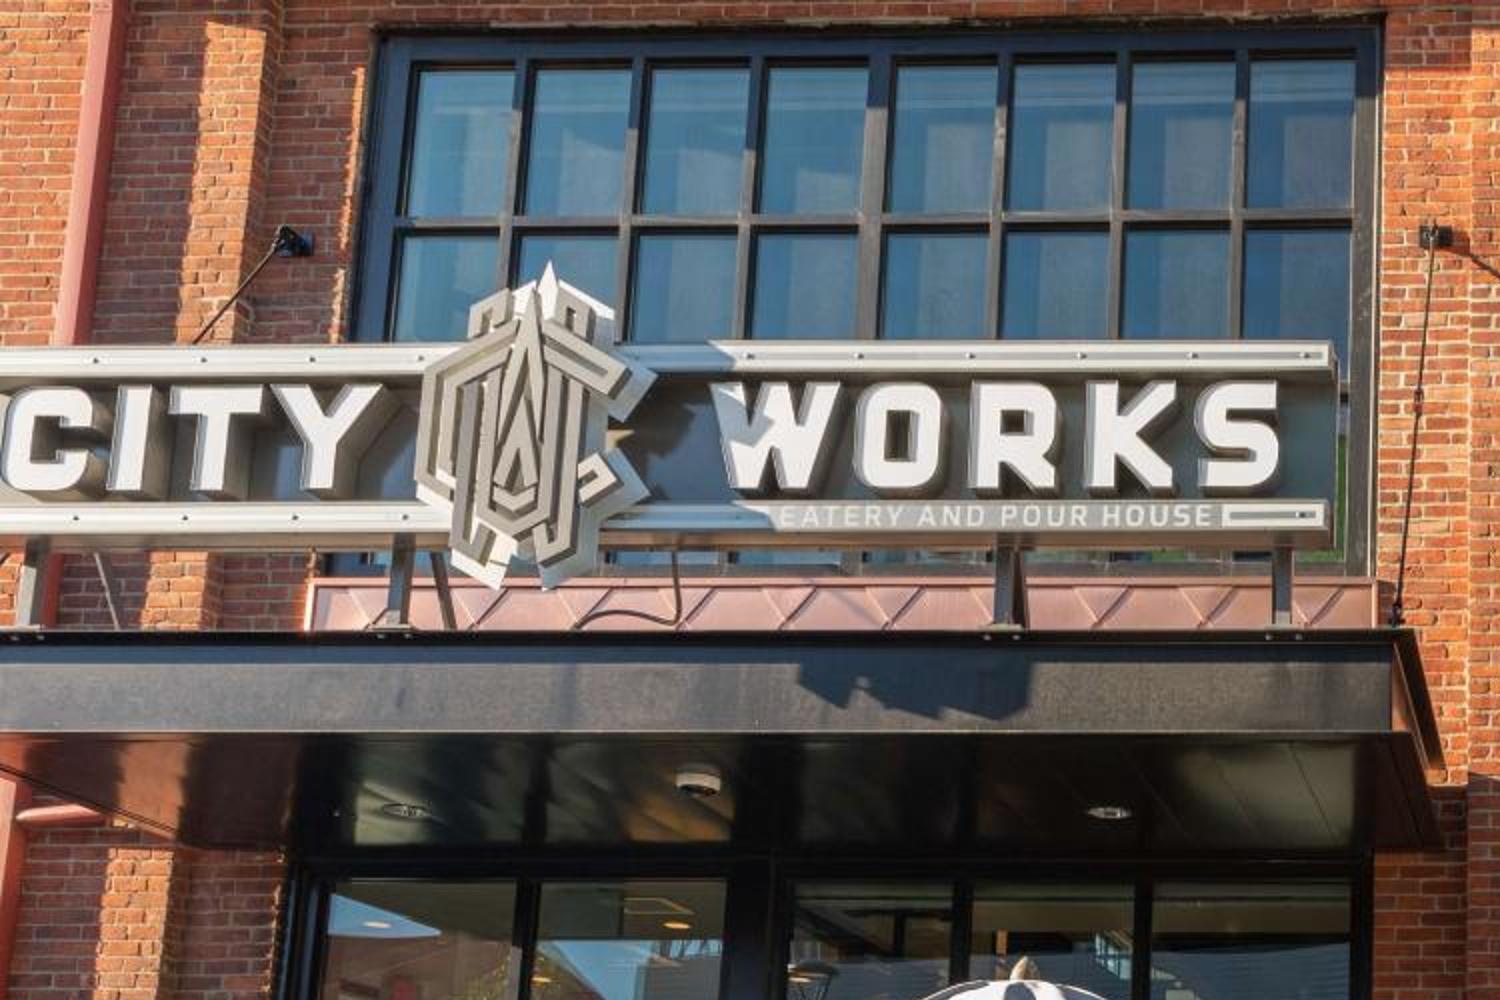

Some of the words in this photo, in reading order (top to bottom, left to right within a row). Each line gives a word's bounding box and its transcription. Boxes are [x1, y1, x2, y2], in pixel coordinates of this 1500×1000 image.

[3, 384, 382, 491] CITY
[709, 380, 1280, 489] WORKS
[779, 504, 904, 528] EATERY
[917, 504, 986, 528] AND
[1001, 504, 1088, 528] POUR
[1103, 504, 1214, 528] HOUSE
